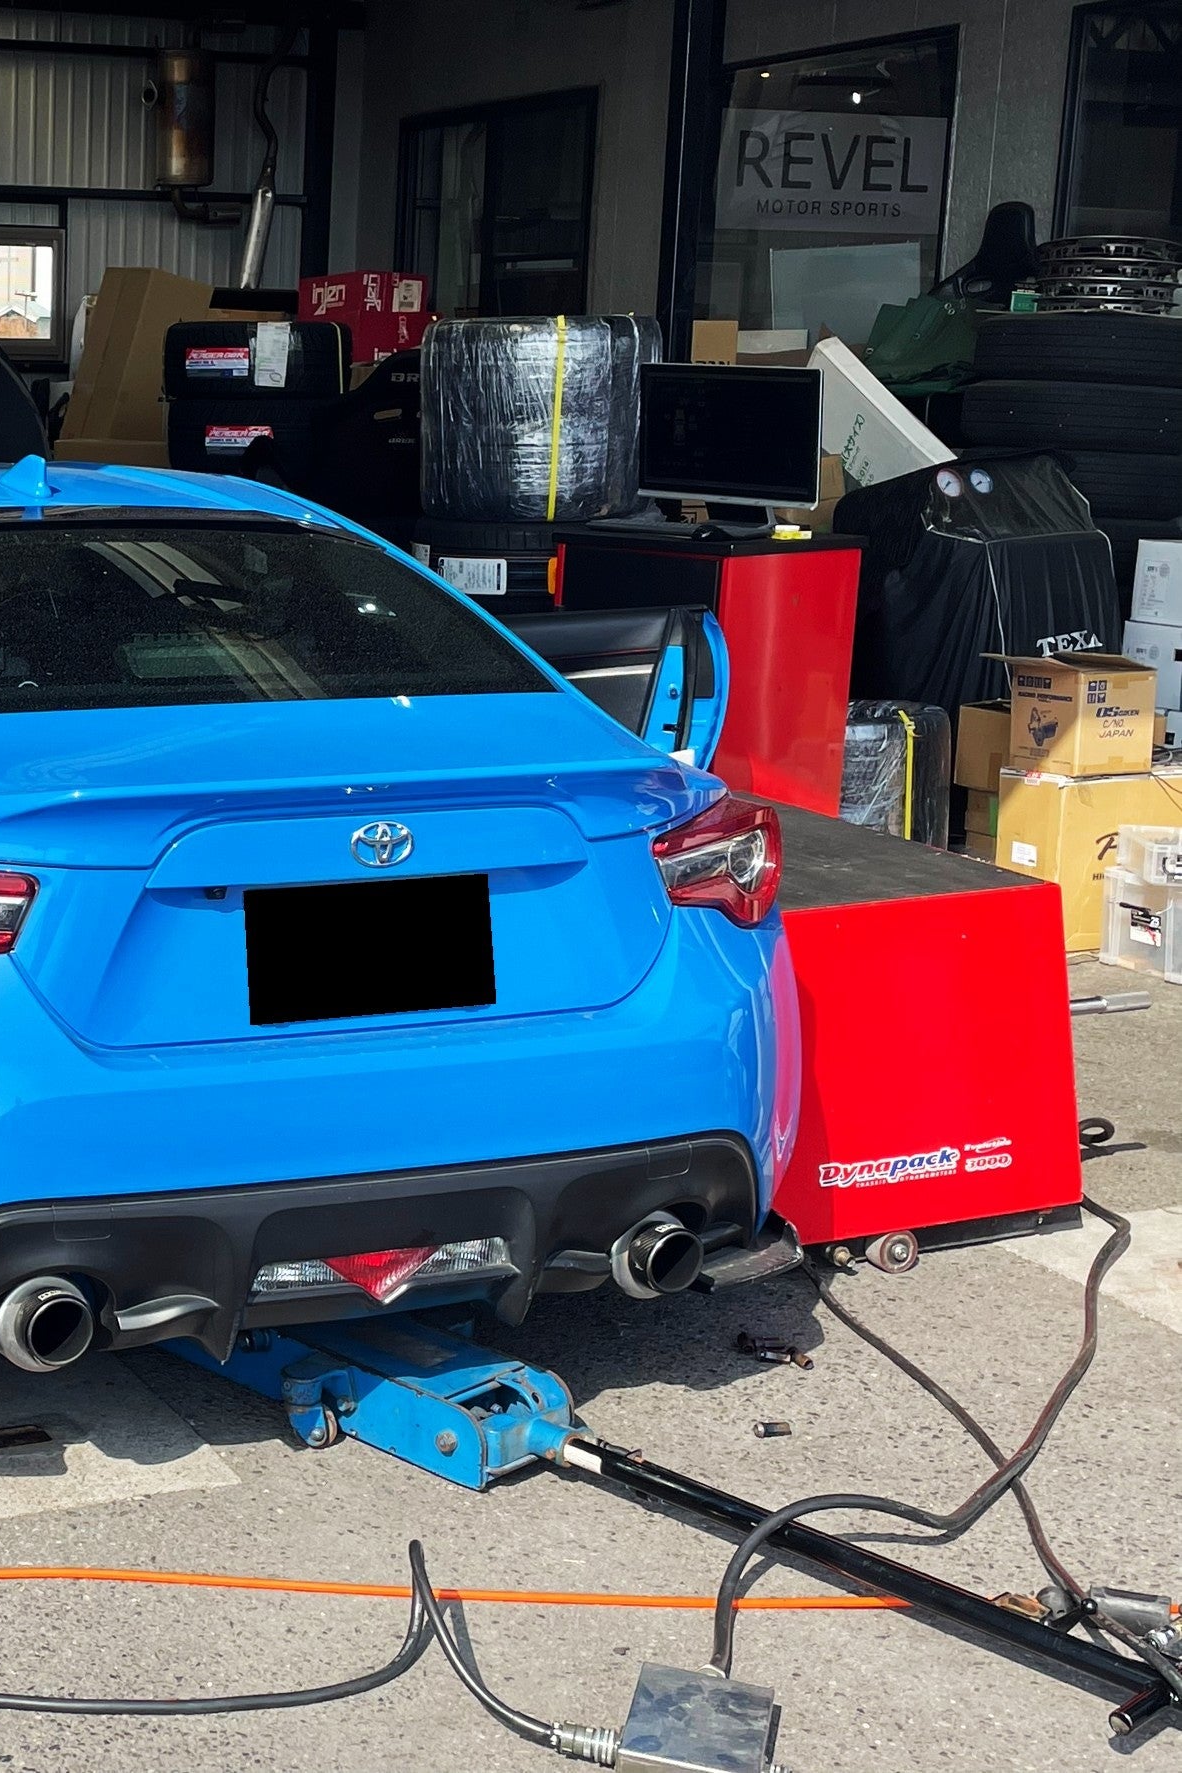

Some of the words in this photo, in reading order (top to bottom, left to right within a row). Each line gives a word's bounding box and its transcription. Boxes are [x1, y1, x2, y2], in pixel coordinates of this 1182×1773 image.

[735, 129, 929, 193] REVEL
[756, 198, 822, 215] MOTOR
[829, 200, 902, 218] SPORTS
[1098, 729, 1134, 738] JAPAN
[819, 1147, 960, 1188] Dynapack
[965, 1154, 1012, 1172] 3000
